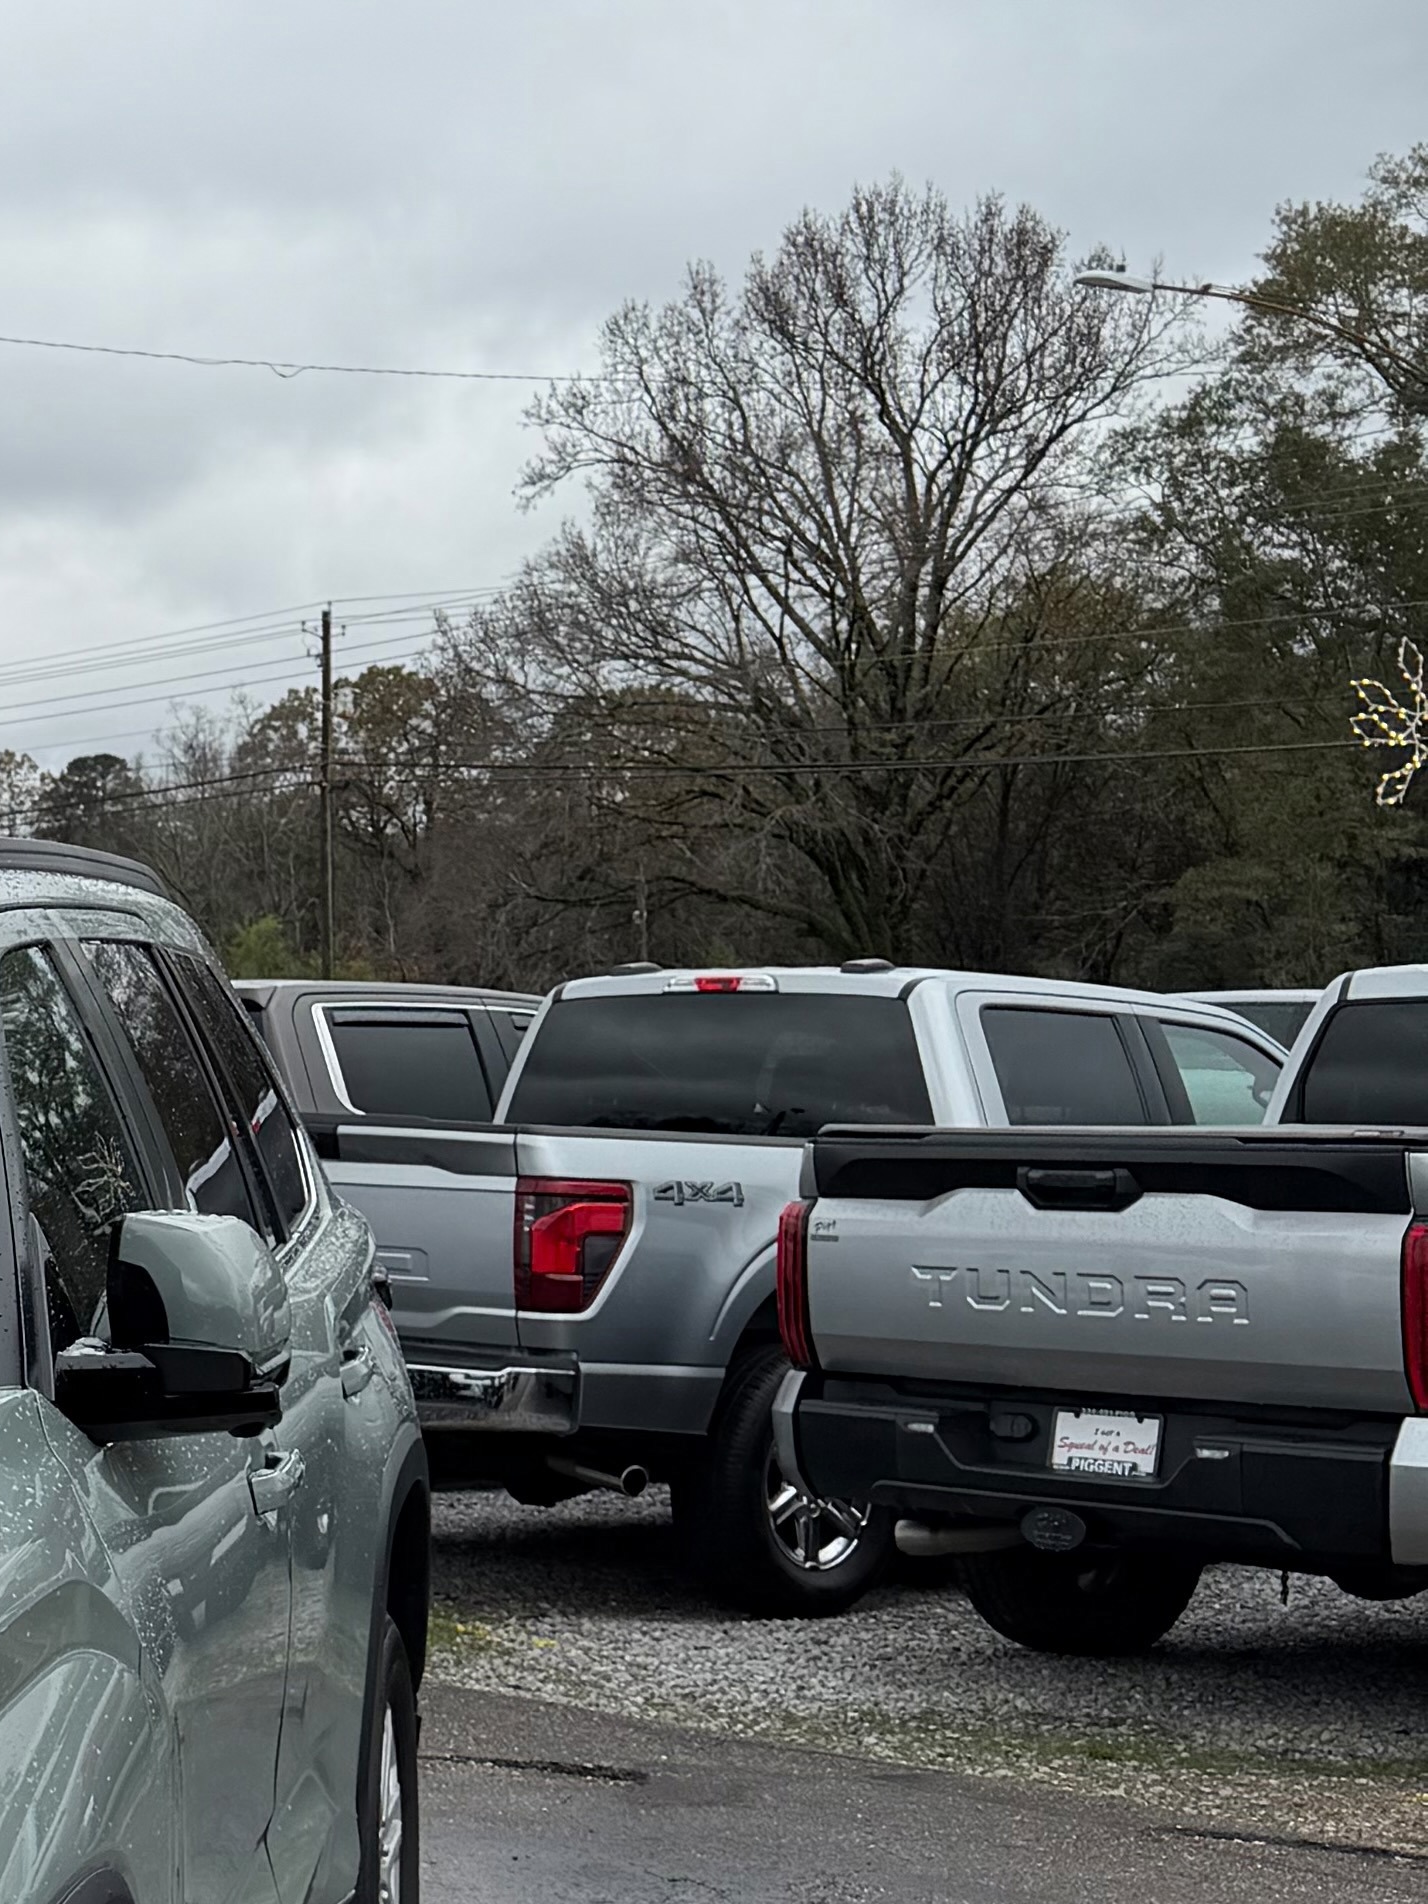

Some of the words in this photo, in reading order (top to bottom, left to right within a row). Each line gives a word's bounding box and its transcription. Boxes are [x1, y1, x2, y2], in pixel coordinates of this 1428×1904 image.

[910, 1264, 1249, 1324] TUNDRA
[1058, 1436, 1098, 1452] Squeal
[1098, 1440, 1112, 1455] of
[1112, 1444, 1120, 1453] a
[1071, 1457, 1133, 1476] PIGGENT
